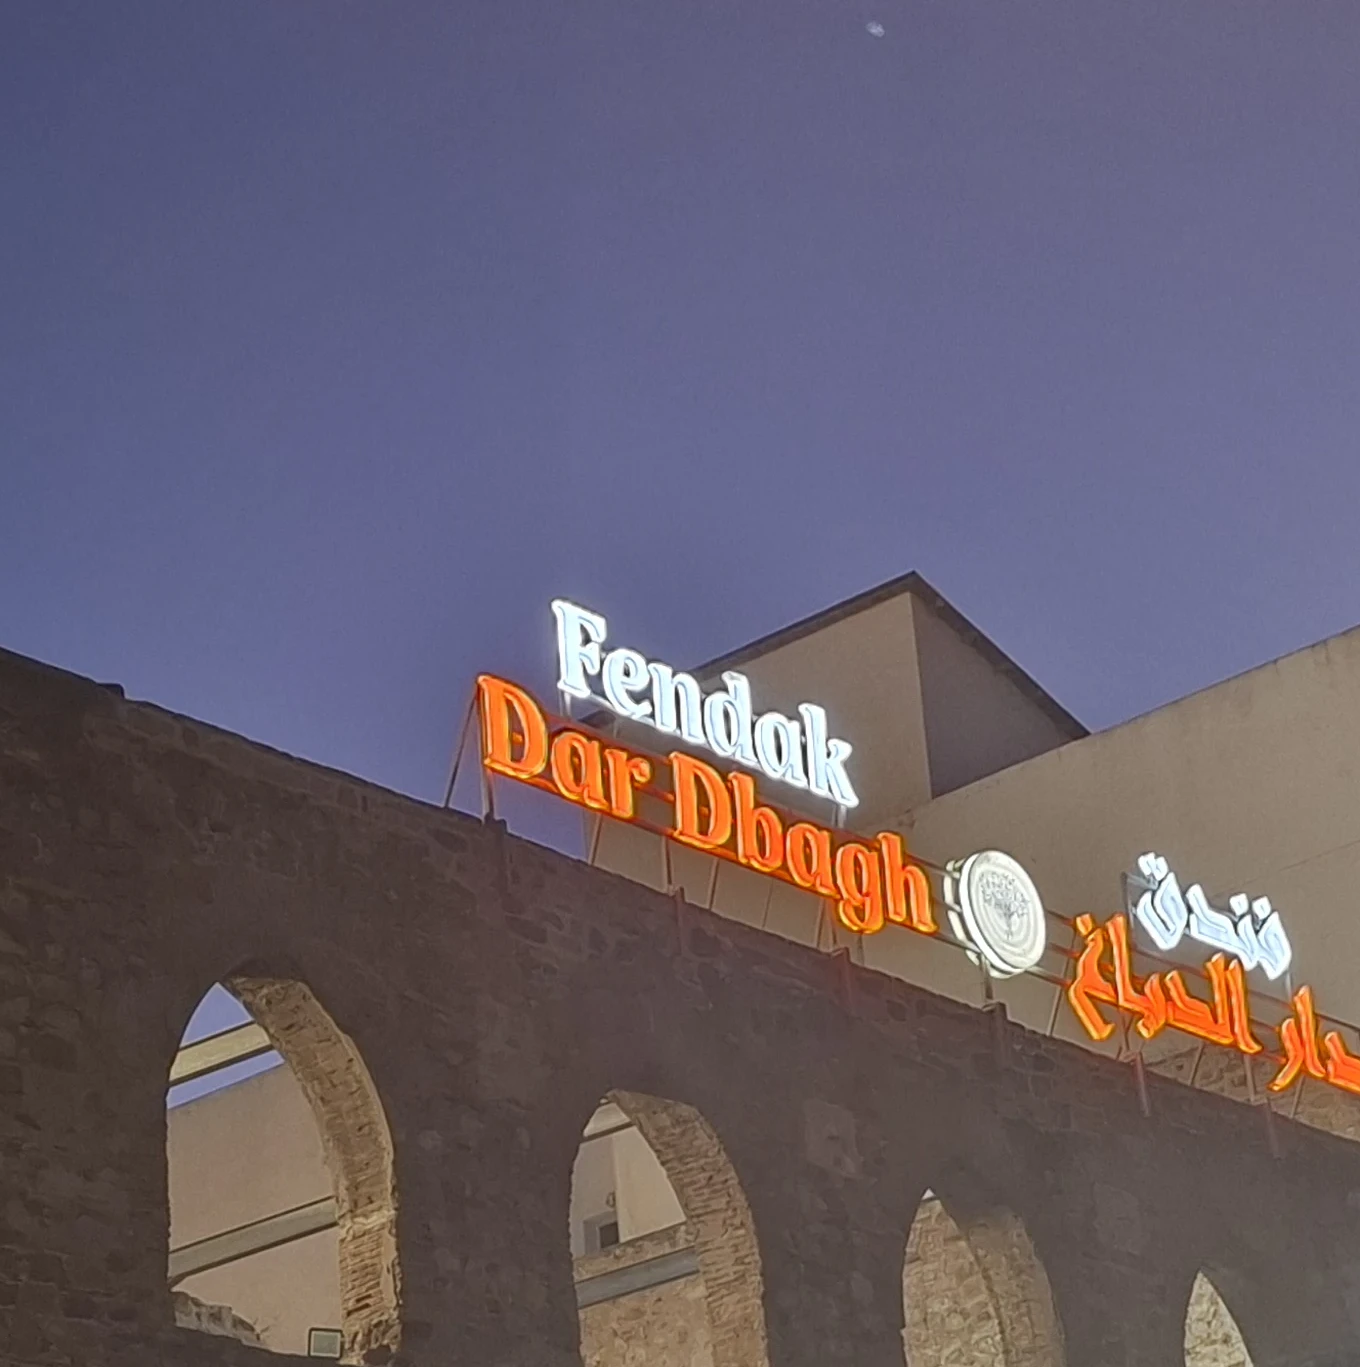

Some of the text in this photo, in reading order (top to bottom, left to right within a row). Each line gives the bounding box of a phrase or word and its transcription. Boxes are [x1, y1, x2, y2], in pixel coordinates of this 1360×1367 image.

[551, 598, 859, 808] Fendak
[476, 673, 938, 935] Dar Dbagh
[1068, 913, 1264, 1054] الدباغ
[1136, 852, 1293, 981] فندق
